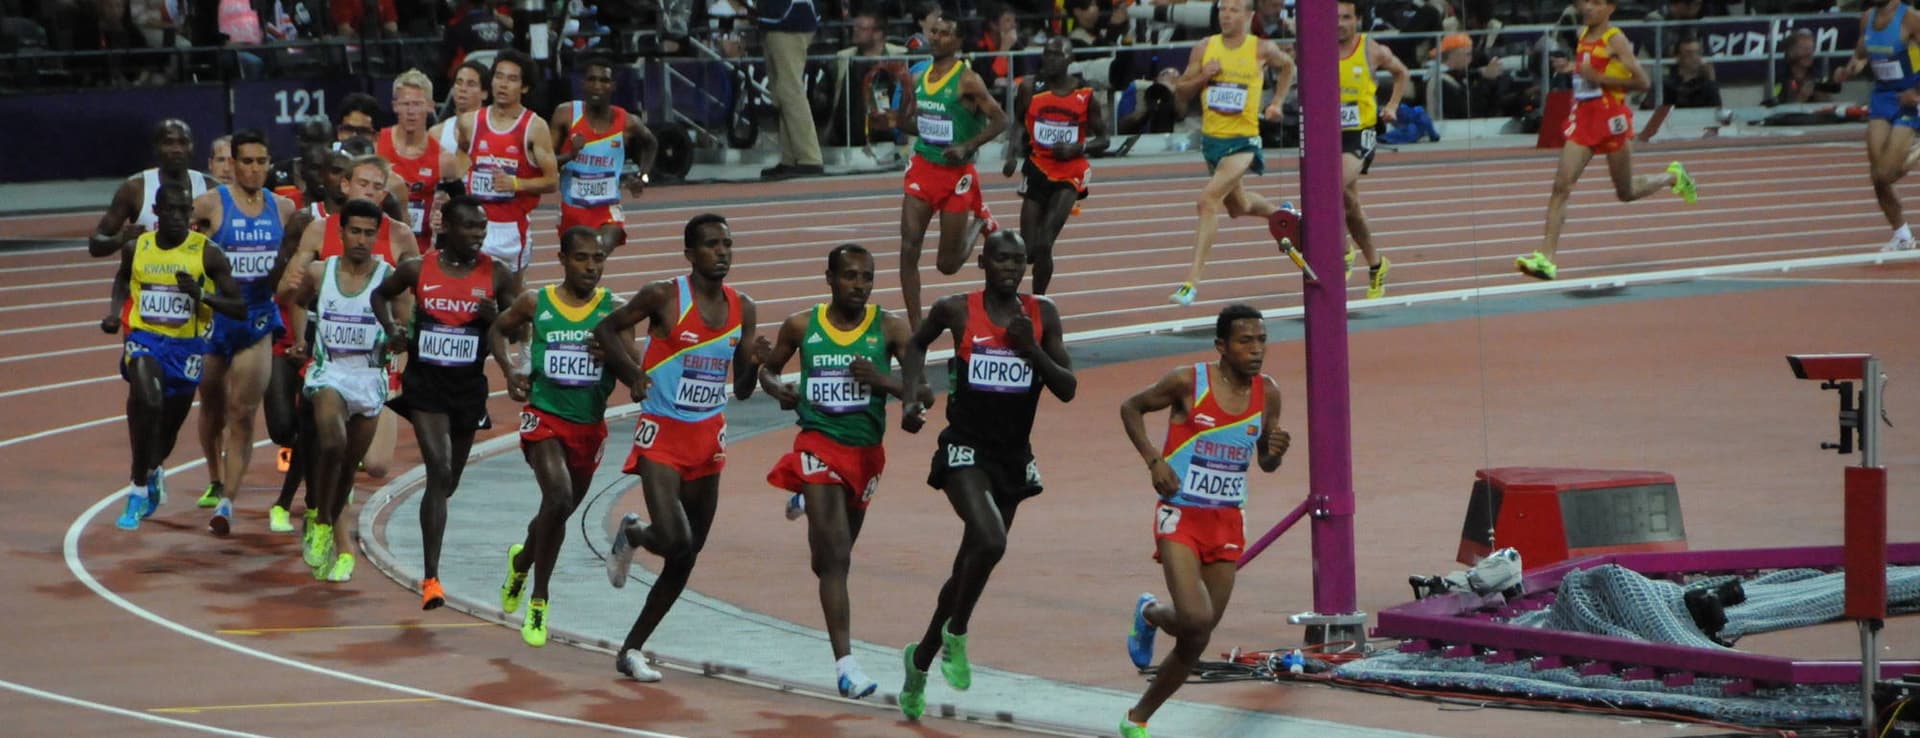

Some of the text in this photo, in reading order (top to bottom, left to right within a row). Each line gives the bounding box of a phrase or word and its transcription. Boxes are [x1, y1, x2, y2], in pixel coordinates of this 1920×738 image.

[1708, 17, 1839, 58] eratin
[274, 89, 329, 124] 121
[1039, 127, 1073, 144] KIPSIRO
[234, 229, 273, 241] Italia
[232, 255, 277, 273] MEUCC
[141, 294, 191, 314] KAJUGA
[324, 324, 368, 345] AL-OUTAIBI
[422, 335, 474, 358] MUCHIRI
[549, 354, 599, 377] BEKELE
[972, 359, 1031, 383] KIPROP
[812, 381, 867, 402] BEKELE
[635, 421, 657, 446] 20
[1194, 439, 1249, 460] ERITREA
[1190, 469, 1244, 497] TADESE
[1159, 507, 1174, 531] 7
